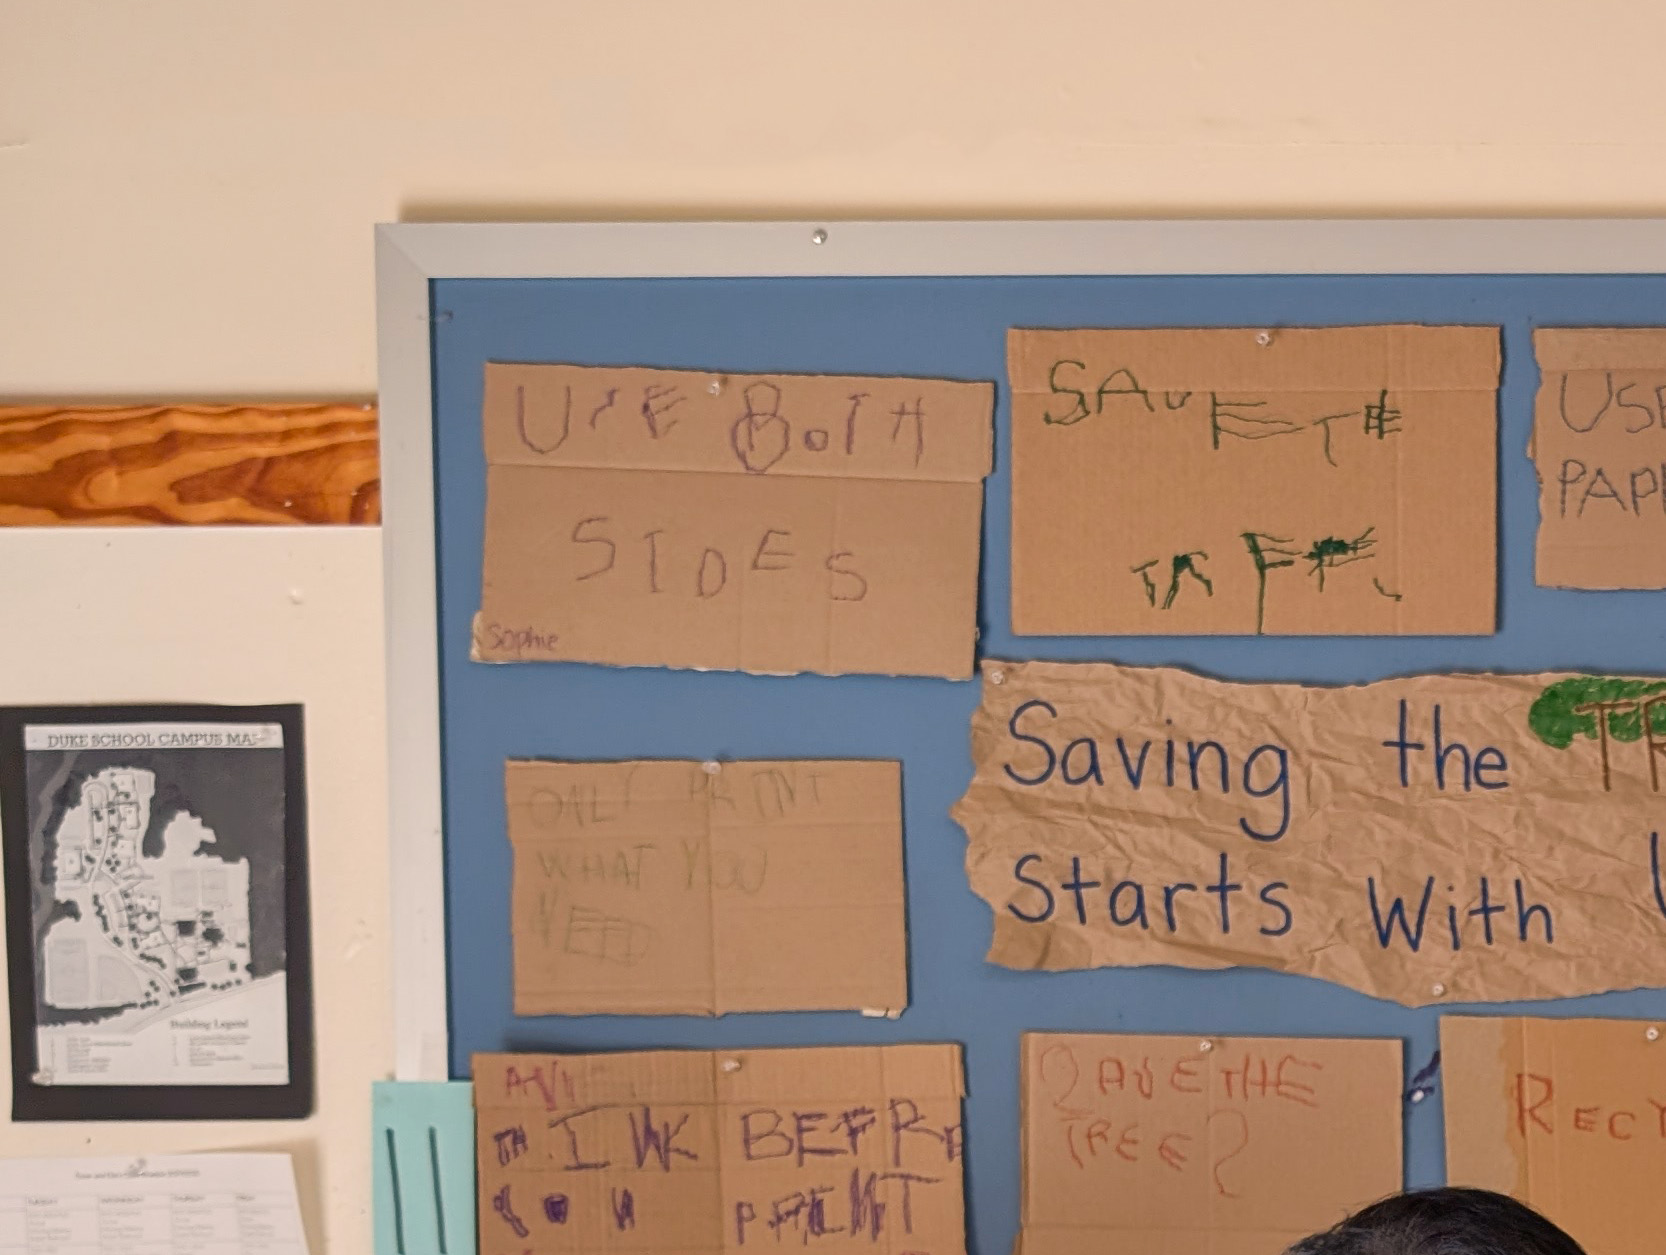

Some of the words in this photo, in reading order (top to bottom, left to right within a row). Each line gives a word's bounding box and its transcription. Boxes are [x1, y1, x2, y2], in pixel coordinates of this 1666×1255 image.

[571, 516, 869, 603] SIDES
[47, 735, 88, 748] DUKE
[91, 734, 155, 747] SCHOOL
[158, 733, 223, 747] CAMPUS
[226, 733, 258, 747] MA
[1003, 698, 1292, 841] Saving
[1382, 698, 1508, 792] the
[1006, 852, 1294, 937] Starts
[1368, 875, 1556, 953] With
[1219, 1053, 1324, 1109] THE
